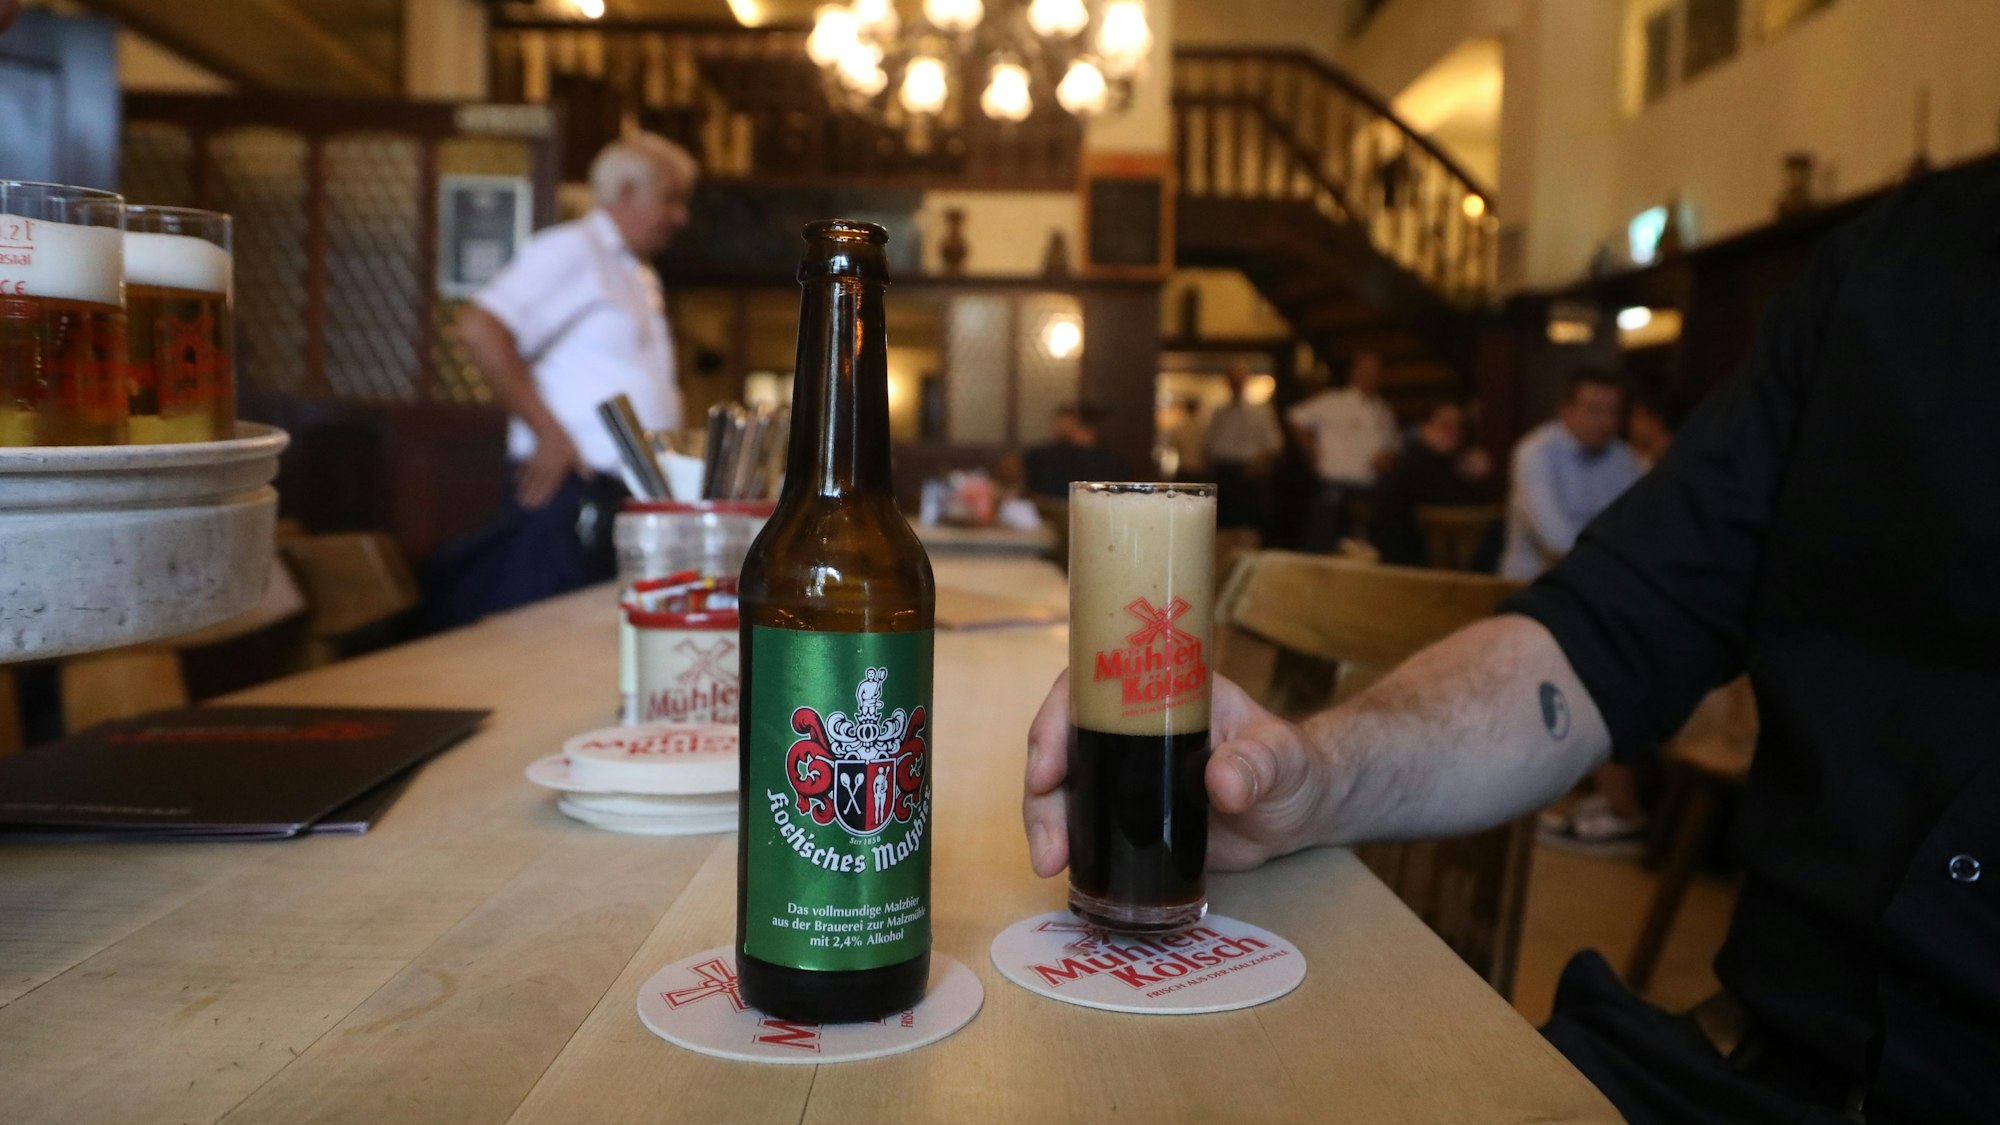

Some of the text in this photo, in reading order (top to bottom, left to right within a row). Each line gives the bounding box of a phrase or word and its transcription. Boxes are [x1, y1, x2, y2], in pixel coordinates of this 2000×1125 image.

[1093, 640, 1202, 682] Mühlen
[646, 681, 739, 721] Mühle
[872, 785, 931, 873] Malzbier
[772, 916, 789, 928] aus
[792, 918, 811, 930] der
[814, 920, 863, 933] Brauerei
[866, 920, 884, 931] zur
[787, 896, 920, 919] Das vollmundige Malzbier
[810, 928, 904, 949] mit 2,4% Alkohol
[1034, 927, 1221, 986] Mühlen
[1109, 936, 1269, 990] Kölsch
[1146, 949, 1289, 998] FRISCH AUS DER MALZMÜHLE
